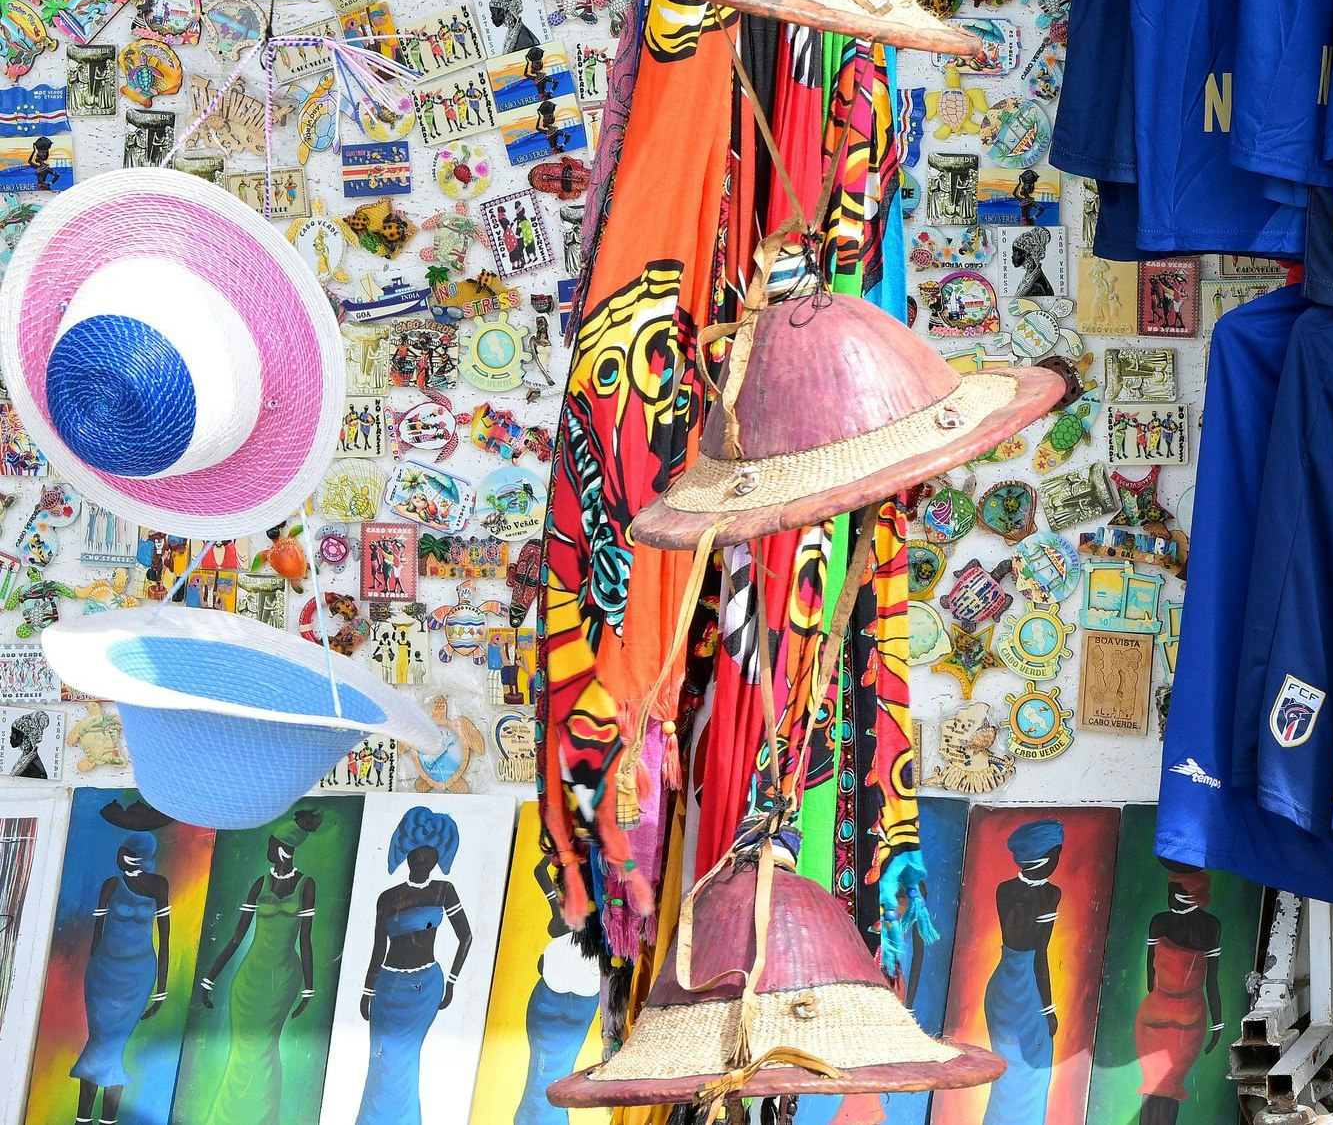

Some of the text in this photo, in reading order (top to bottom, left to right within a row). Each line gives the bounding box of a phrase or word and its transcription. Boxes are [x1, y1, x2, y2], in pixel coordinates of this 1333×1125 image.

[460, 5, 482, 60] NO STRESS
[477, 71, 495, 127] NO STRESS
[411, 90, 429, 145] CABO VERDE
[511, 149, 550, 165] CABO VERDE
[979, 215, 1019, 224] CABO VERDE
[299, 220, 339, 238] CABO VERDE
[1146, 261, 1193, 269] CABO VERDE
[401, 292, 421, 302] INDIA
[435, 283, 520, 318] NO STRESS
[355, 310, 372, 320] GOA
[394, 322, 457, 336] CABO VERDE
[366, 527, 413, 535] CABO VERDE
[1120, 550, 1135, 559] SAL
[430, 565, 497, 579] NO STRESS
[1094, 636, 1141, 648] BOA VISTA
[1001, 647, 1048, 677] CABO VERDE
[1287, 683, 1320, 701] FCF
[1088, 717, 1138, 729] CABO VERDE
[1014, 739, 1066, 759] CABO VERDE
